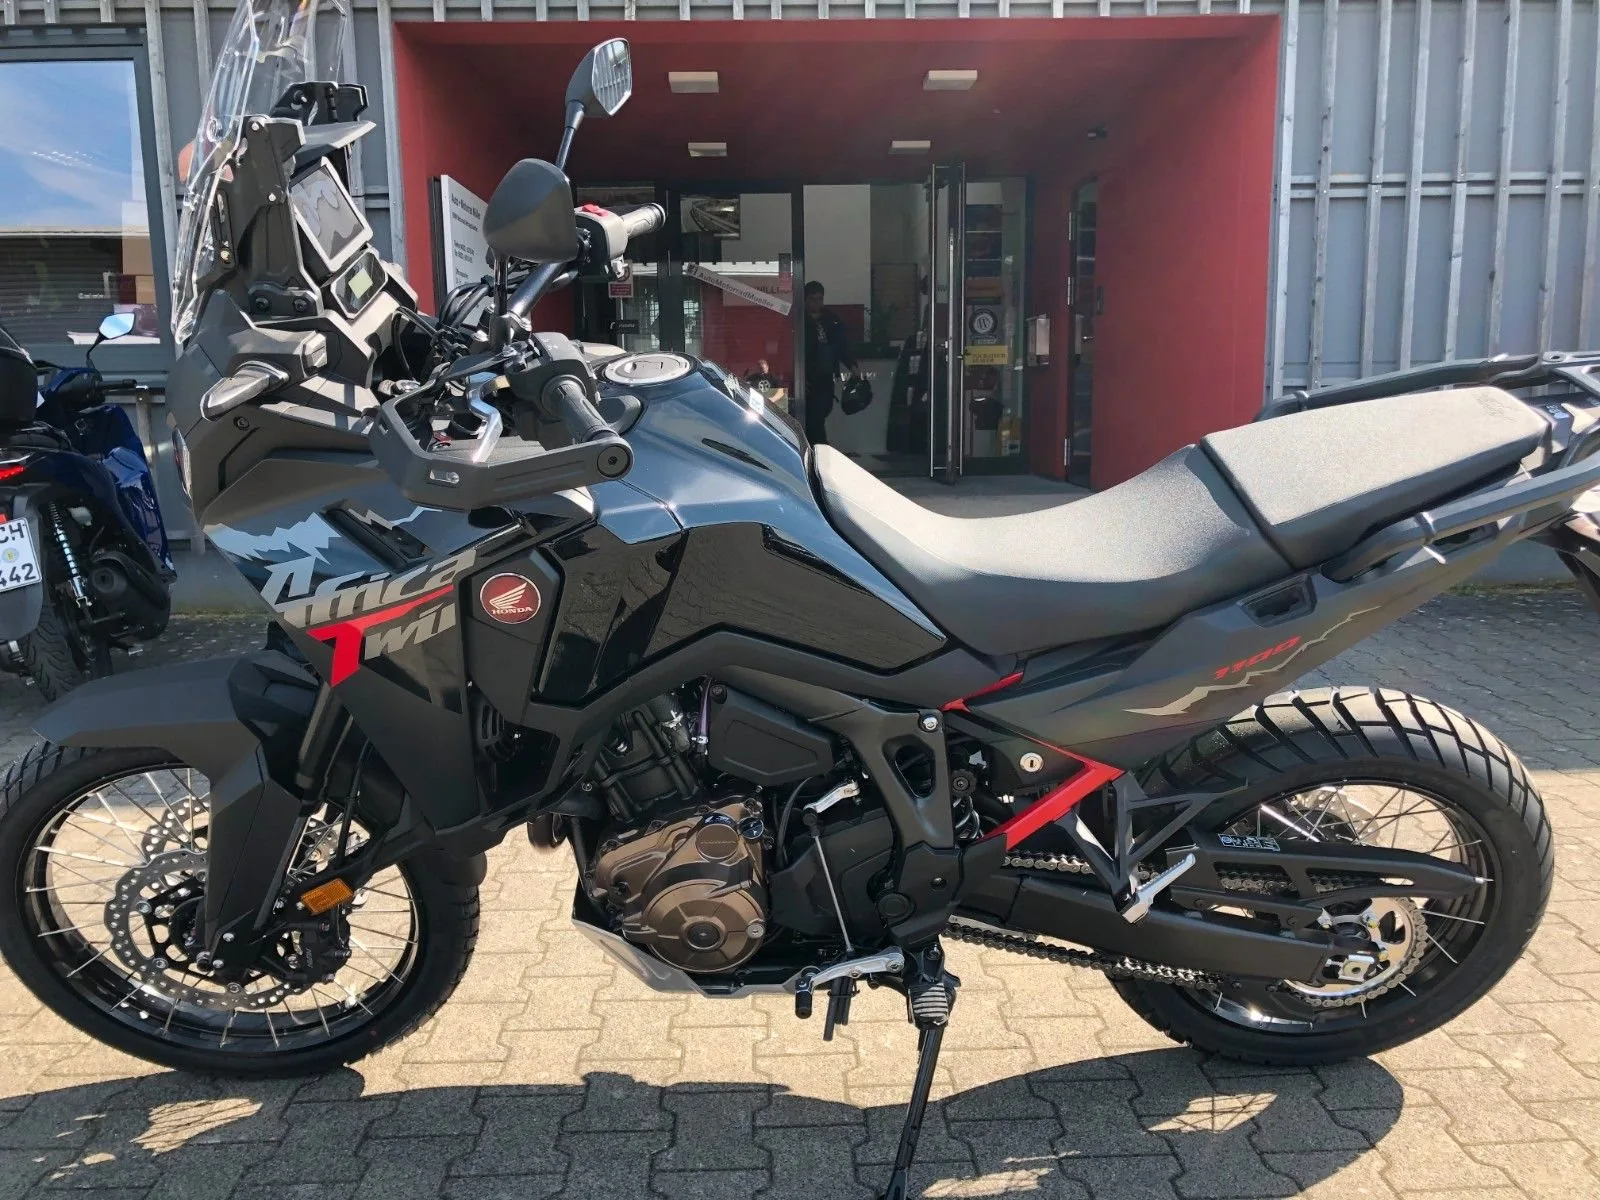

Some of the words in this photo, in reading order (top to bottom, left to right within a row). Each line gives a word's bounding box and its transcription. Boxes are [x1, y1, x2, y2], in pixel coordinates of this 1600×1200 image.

[260, 549, 477, 629] Africa
[491, 606, 534, 615] HONDA
[1213, 635, 1303, 680] 1100
